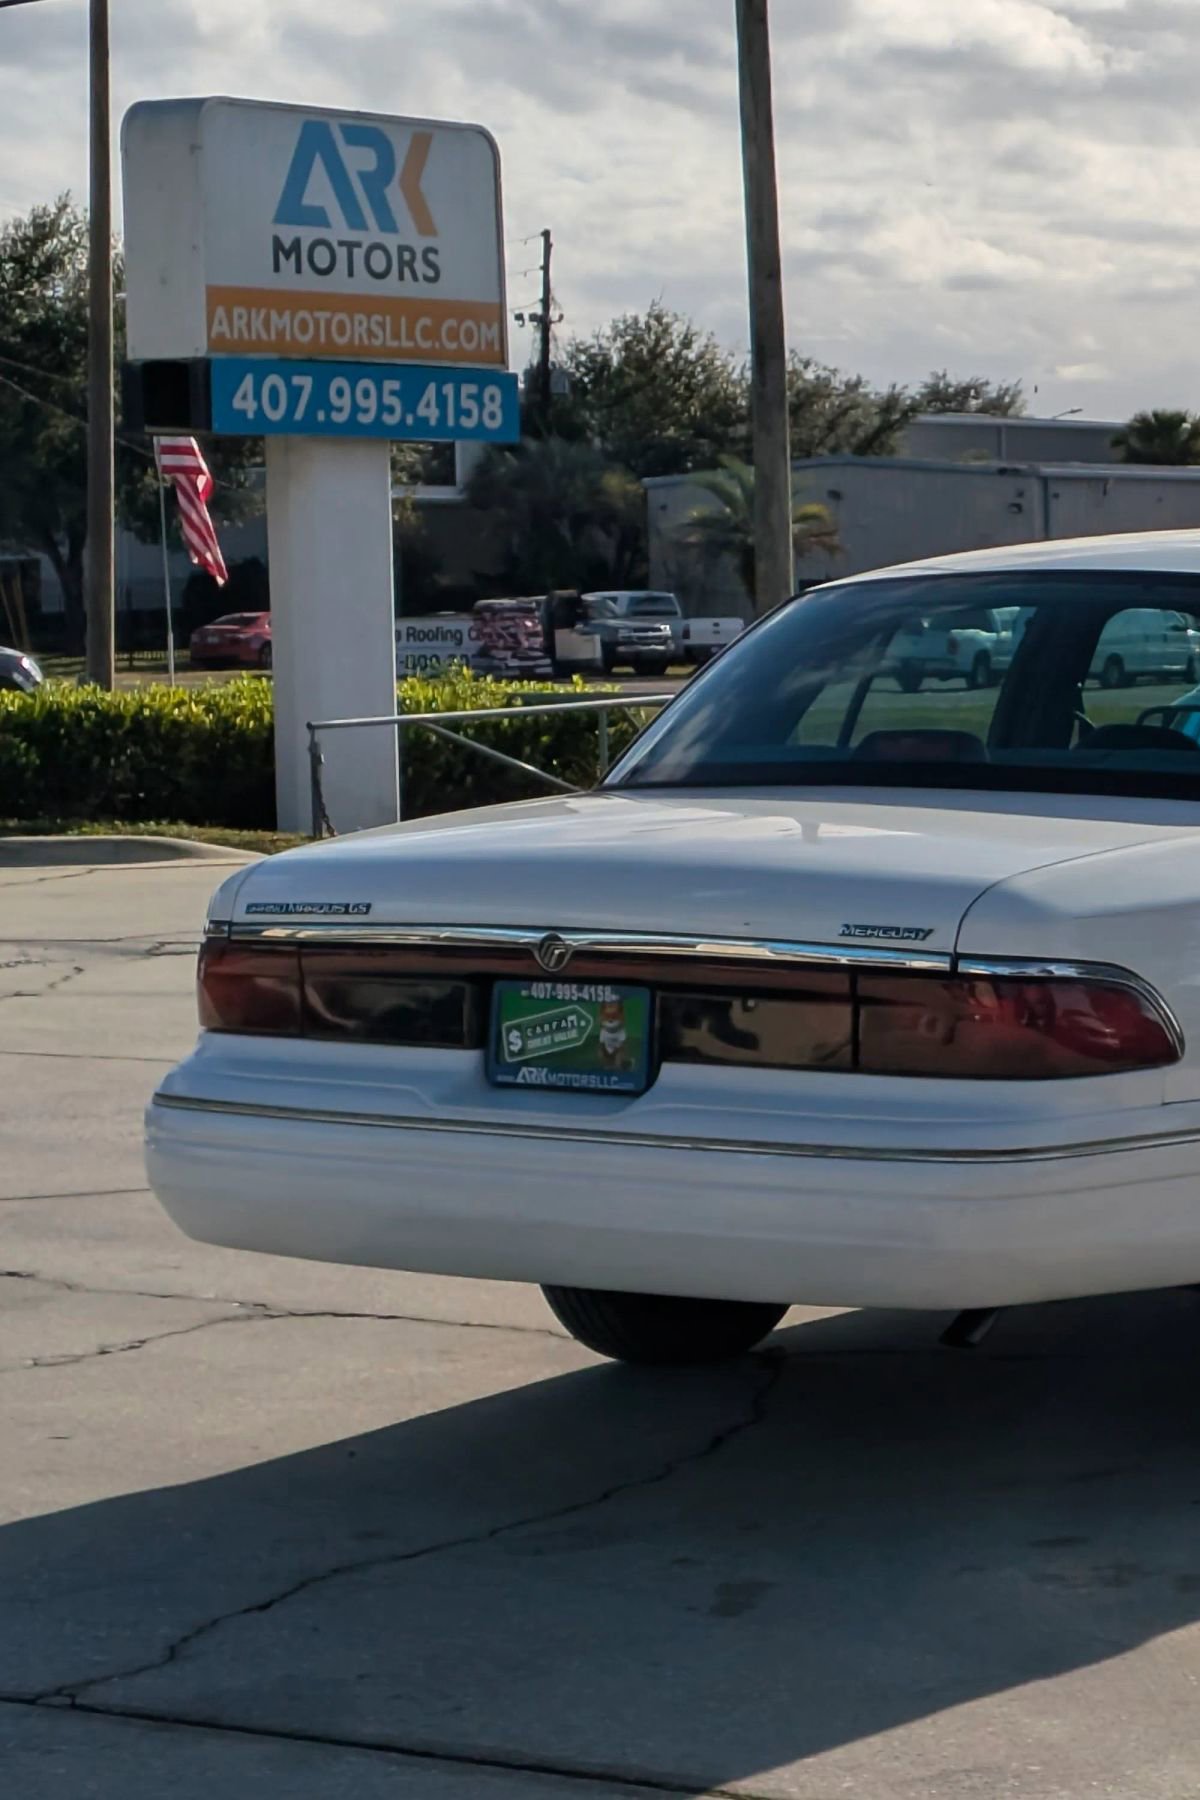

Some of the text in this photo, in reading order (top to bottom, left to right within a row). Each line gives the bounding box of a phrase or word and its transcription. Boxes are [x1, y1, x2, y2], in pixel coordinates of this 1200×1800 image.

[271, 119, 439, 238] ARK
[272, 234, 441, 285] MOTORS
[210, 306, 500, 351] ARKMOTORSLLC.COM
[231, 372, 504, 430] 407.995.4158
[406, 626, 463, 646] Roofing
[838, 924, 935, 941] MERCURY
